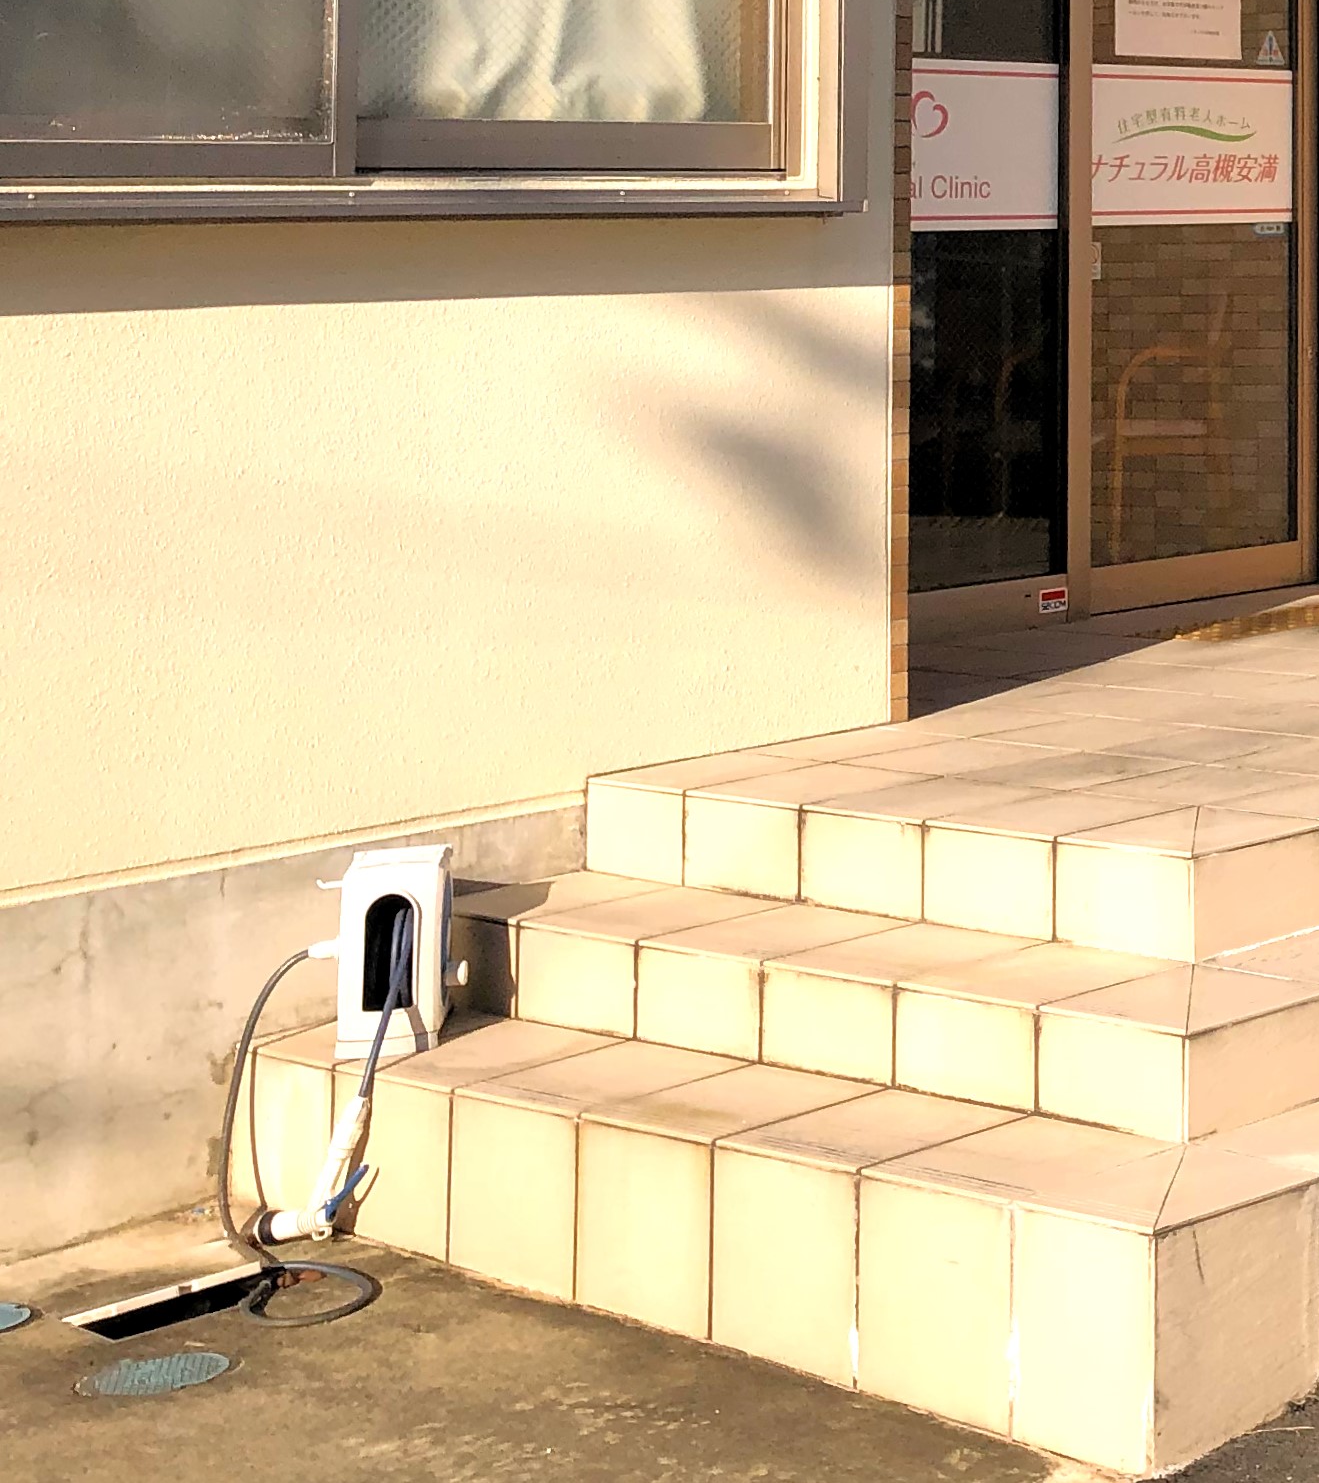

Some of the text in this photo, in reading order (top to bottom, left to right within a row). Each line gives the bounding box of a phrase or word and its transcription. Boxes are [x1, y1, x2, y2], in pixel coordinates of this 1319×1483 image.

[1117, 105, 1251, 134] 住宅型有料老人ホーム
[1091, 153, 1280, 184] ナチュラル高槻安満
[931, 174, 991, 199] Clinic
